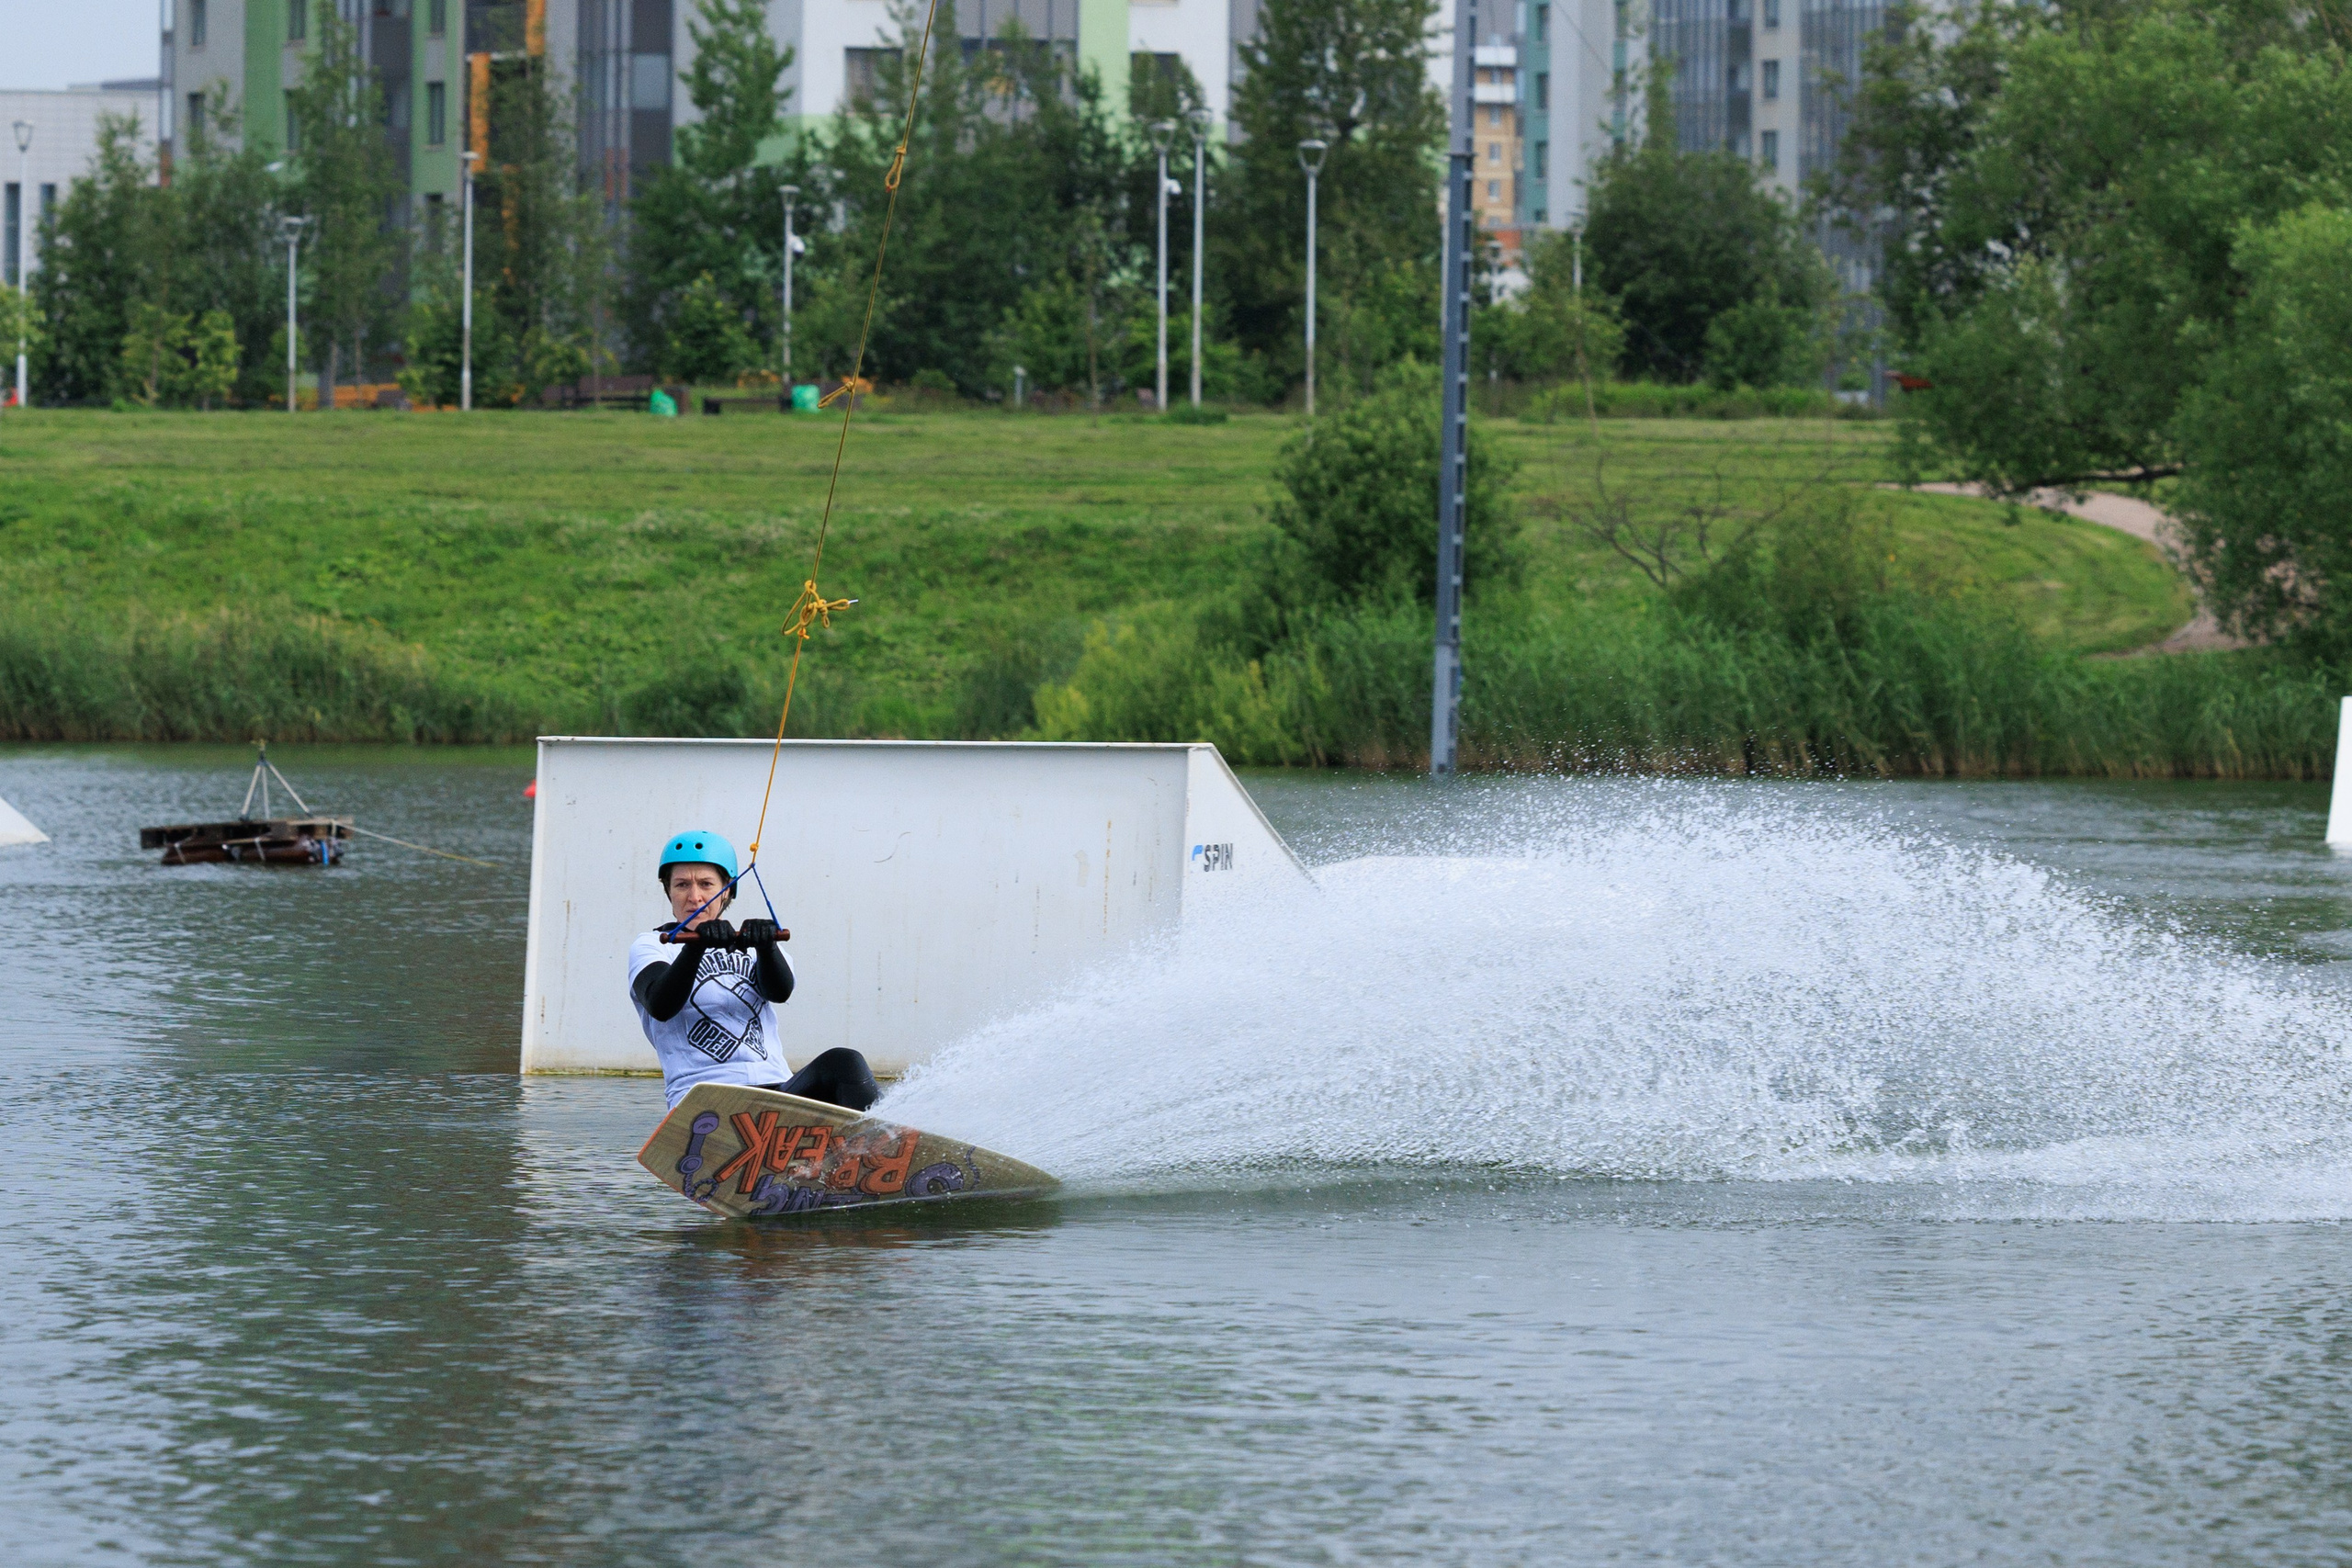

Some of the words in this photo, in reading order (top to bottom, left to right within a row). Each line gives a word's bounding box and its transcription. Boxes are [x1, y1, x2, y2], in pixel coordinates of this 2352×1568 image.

[1204, 843, 1233, 872] SPIN
[690, 1019, 738, 1061] OPEN
[714, 1110, 920, 1194] BREAK
